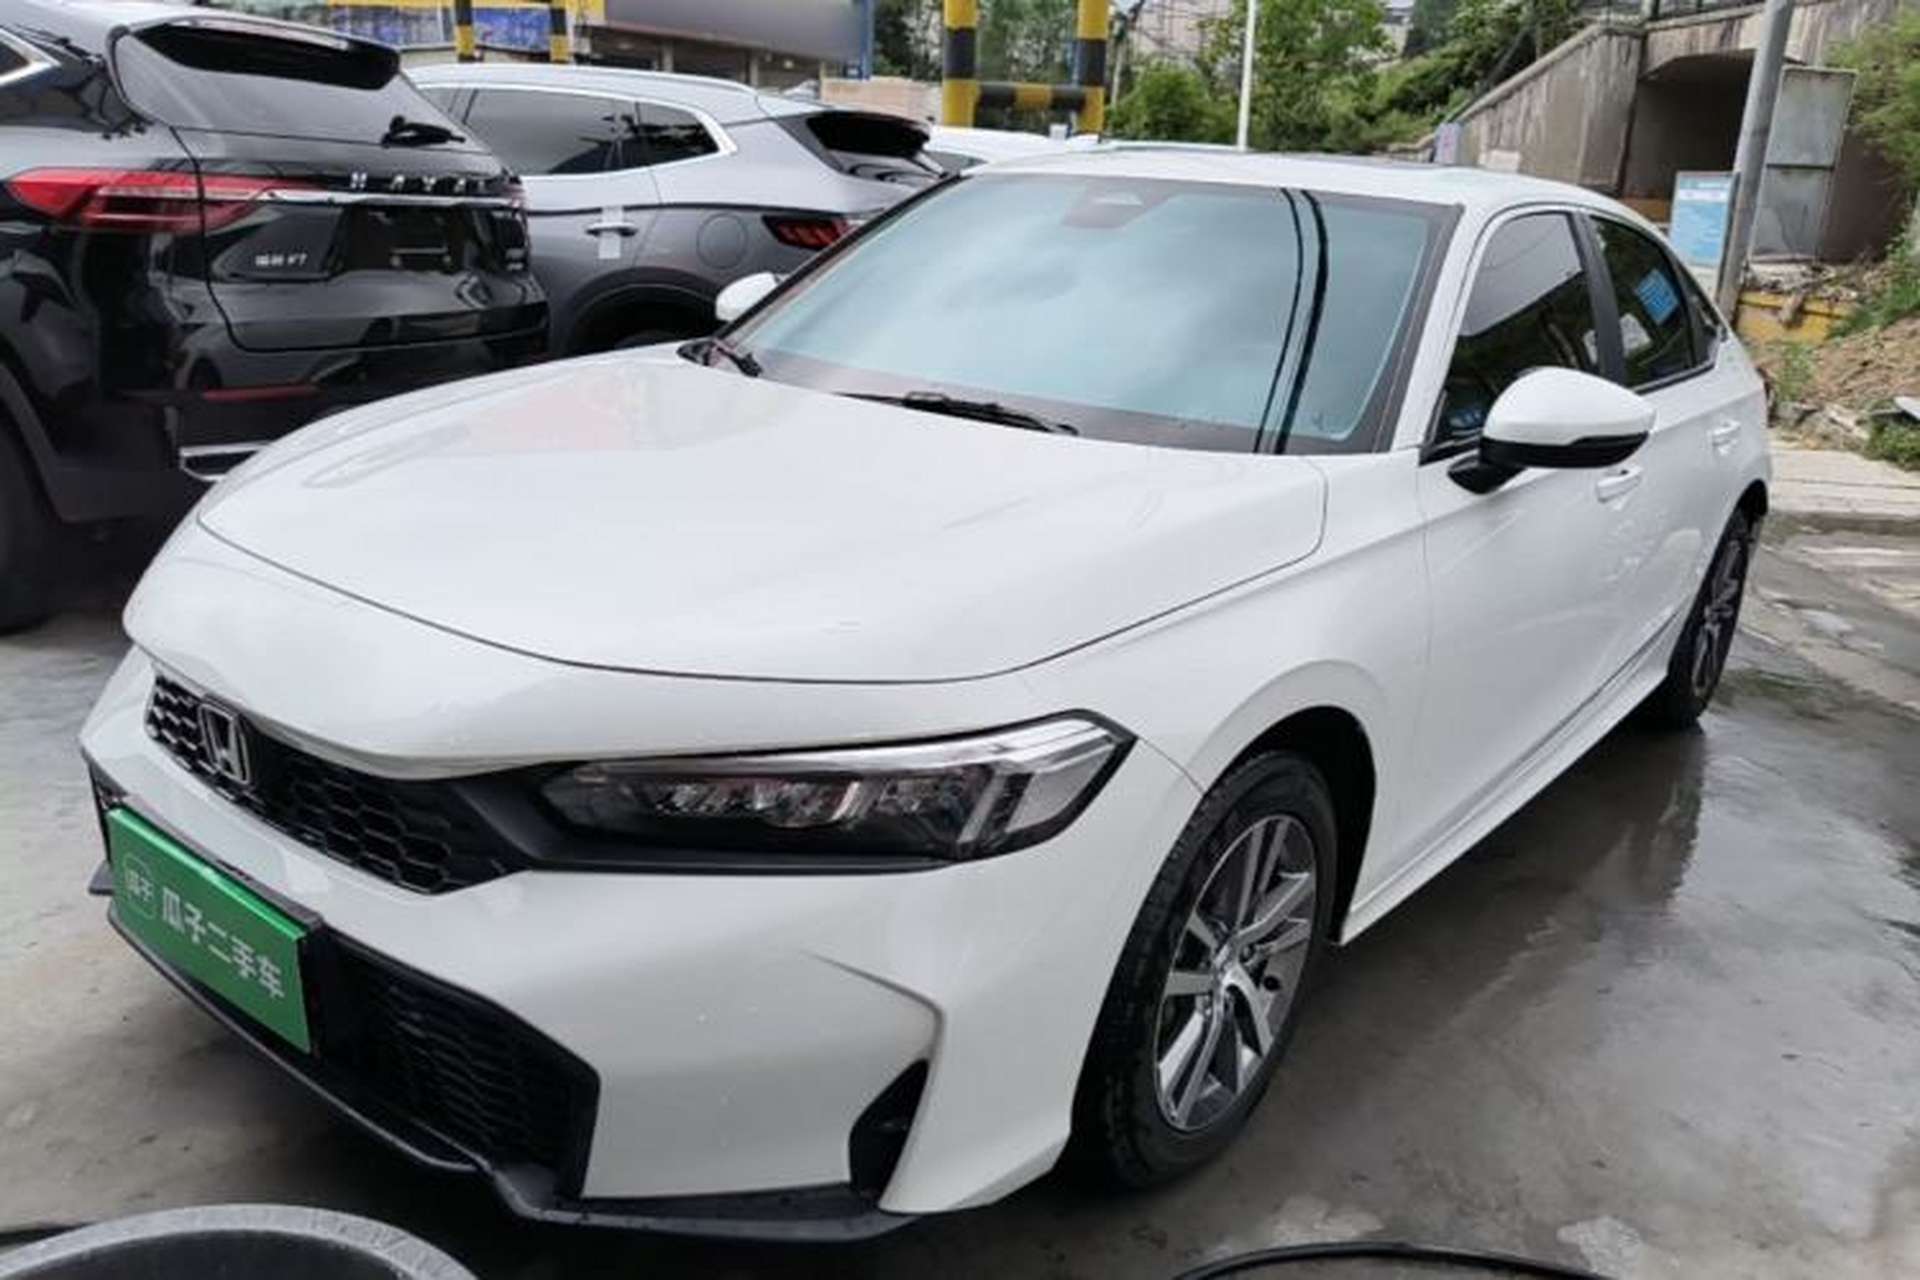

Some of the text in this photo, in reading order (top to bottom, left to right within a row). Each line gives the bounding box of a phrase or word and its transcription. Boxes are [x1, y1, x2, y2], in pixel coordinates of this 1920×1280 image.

[162, 886, 285, 999] 瓜子二手车
